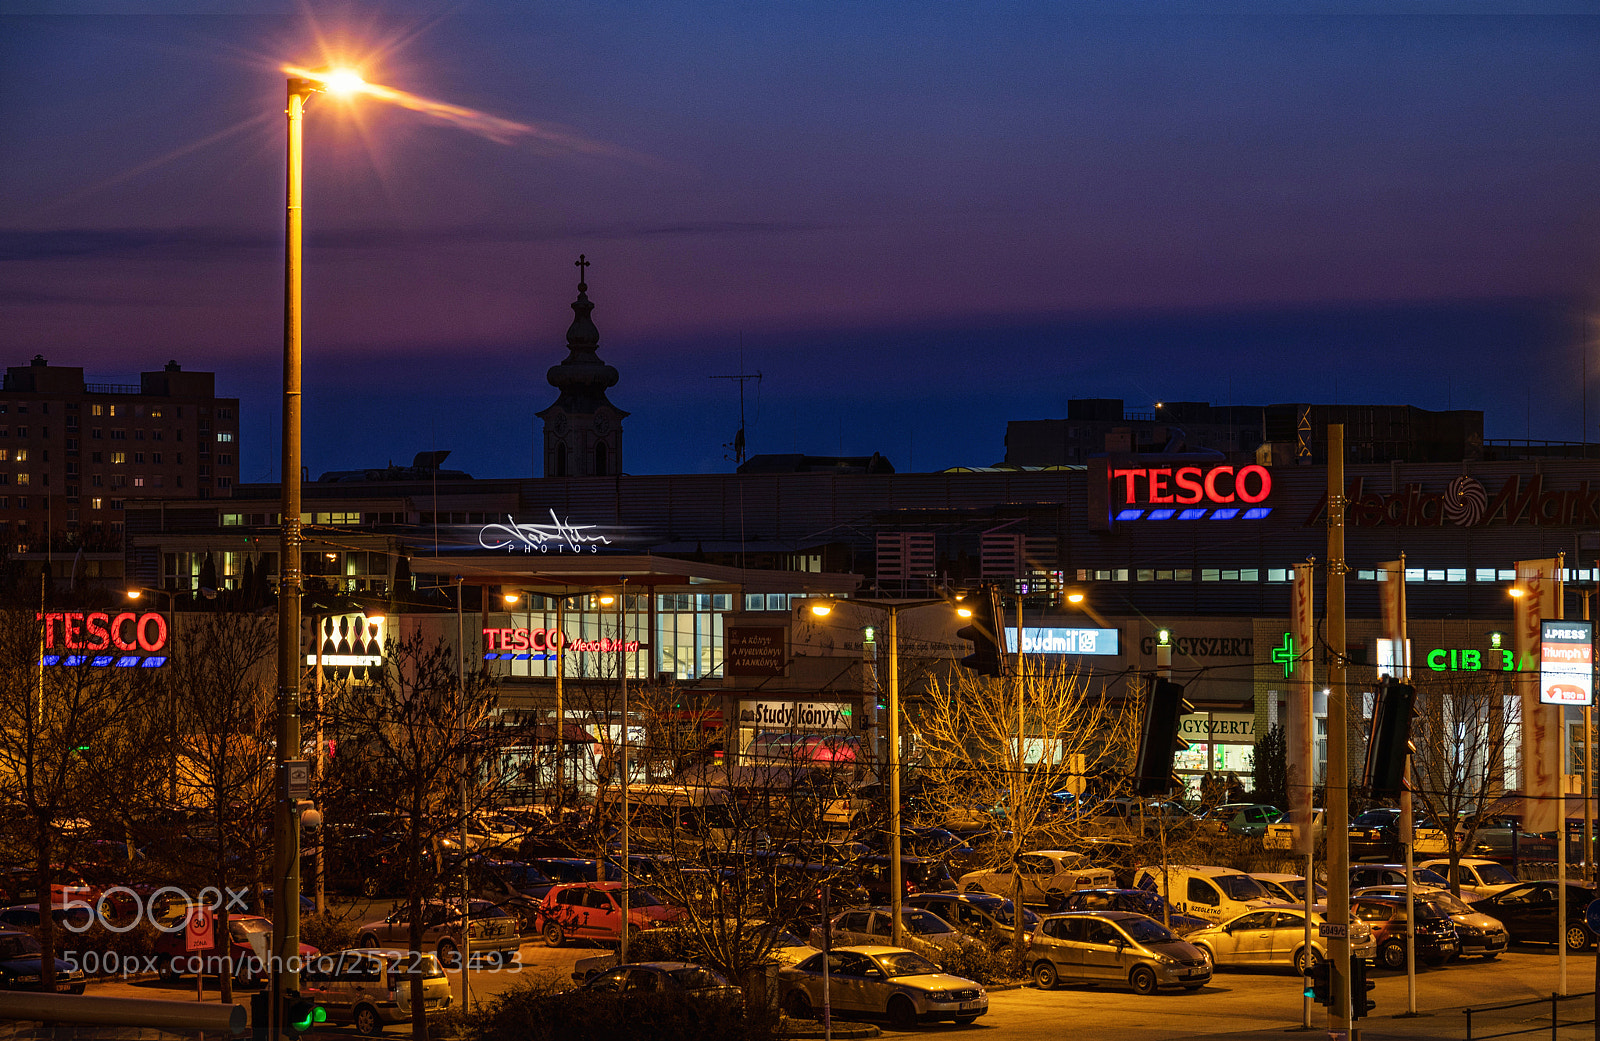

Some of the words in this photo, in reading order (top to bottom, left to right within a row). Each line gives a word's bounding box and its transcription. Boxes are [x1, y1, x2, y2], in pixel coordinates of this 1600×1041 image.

[1114, 464, 1272, 504] TESCO
[1302, 475, 1445, 527] Media
[37, 612, 168, 652] TESCO
[483, 628, 565, 651] TESCO
[569, 638, 601, 653] Media
[609, 638, 639, 653] Mrkt
[1022, 629, 1076, 652] budmil
[1544, 628, 1586, 640] J.PRESS
[1427, 649, 1482, 671] CIB
[1542, 647, 1581, 660] Triumph
[756, 703, 794, 726] Study
[798, 703, 840, 726] könyv
[194, 918, 205, 929] 30
